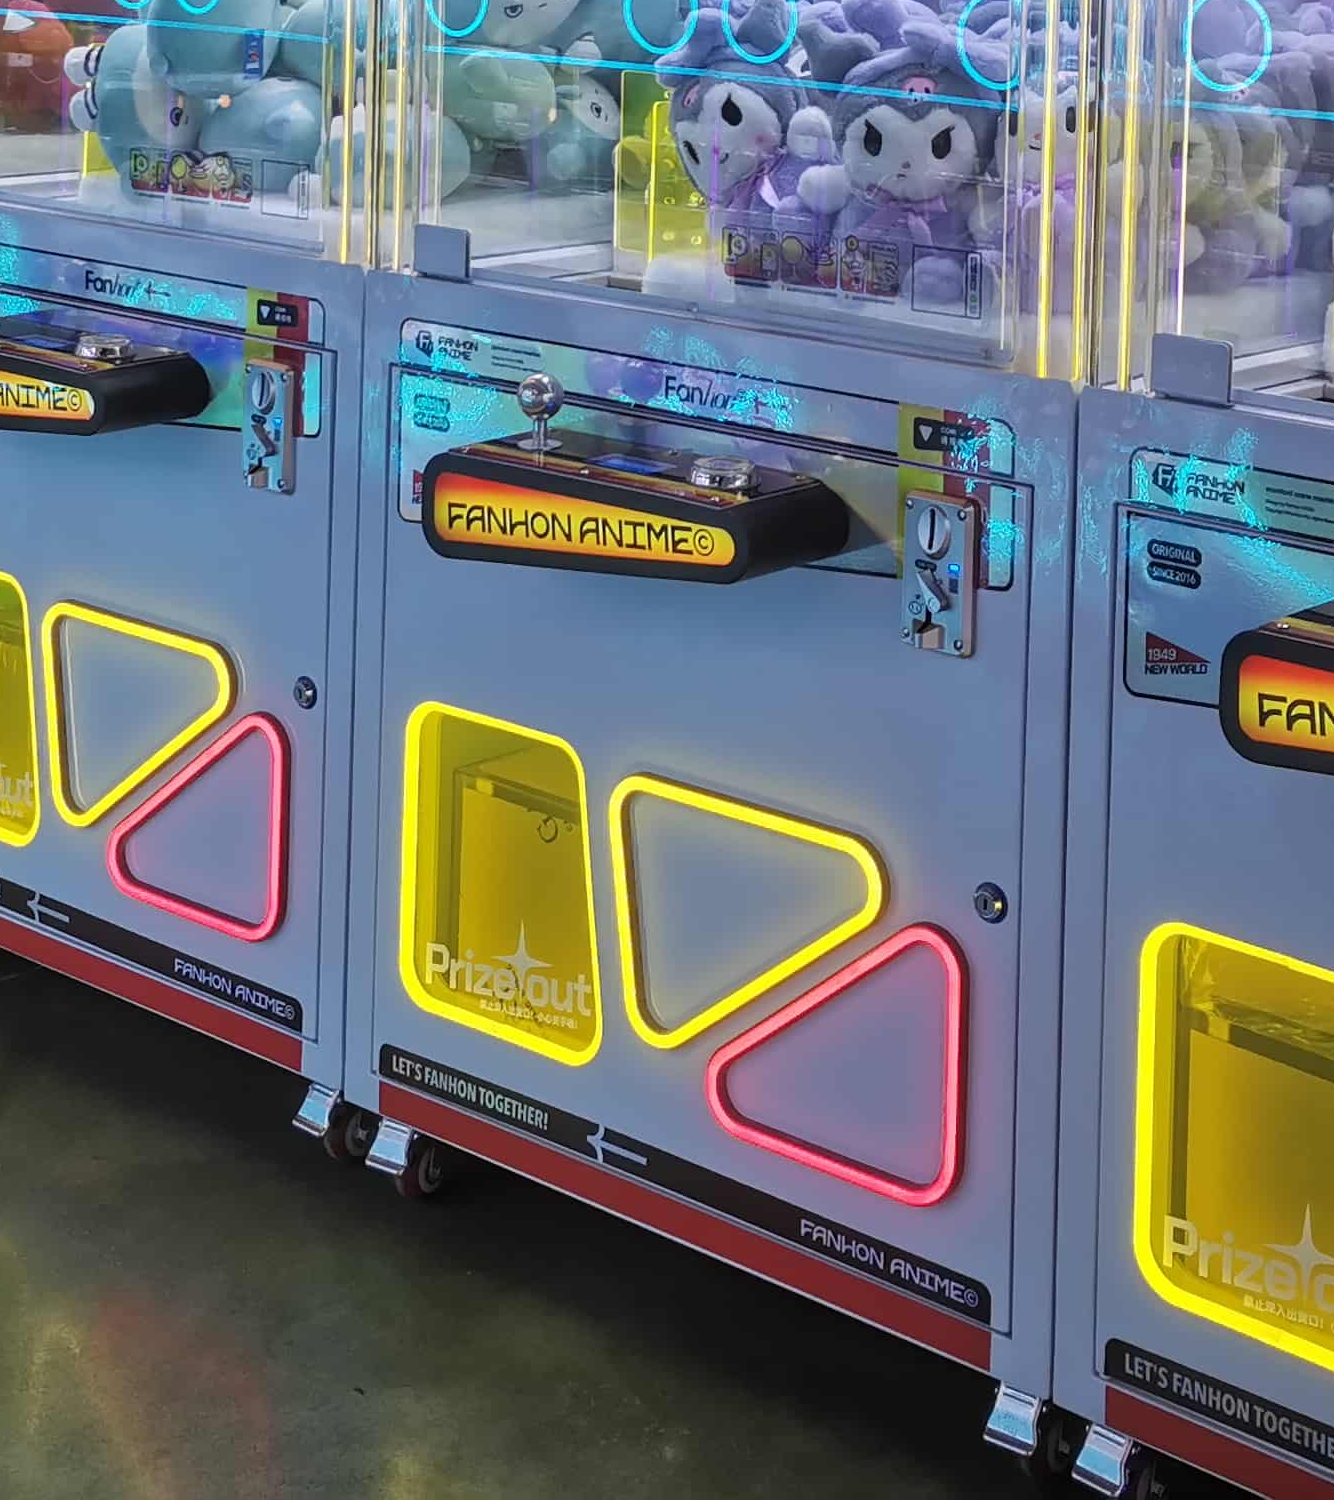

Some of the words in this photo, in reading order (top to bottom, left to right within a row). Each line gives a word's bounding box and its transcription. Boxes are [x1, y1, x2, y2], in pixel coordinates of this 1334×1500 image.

[447, 501, 571, 542] FANHON
[1151, 543, 1198, 564] ORIGINAL
[174, 957, 233, 997] FANHON
[424, 941, 516, 1000] Prize
[527, 973, 593, 1018] out
[391, 1054, 422, 1081] LET'S
[424, 1067, 478, 1103] FANHON
[478, 1086, 550, 1131] TOGETHER!
[799, 1218, 886, 1271] FANHON
[1162, 1213, 1297, 1302] Prize
[1123, 1351, 1169, 1389] LET'S
[1171, 1372, 1251, 1424] FANHON
